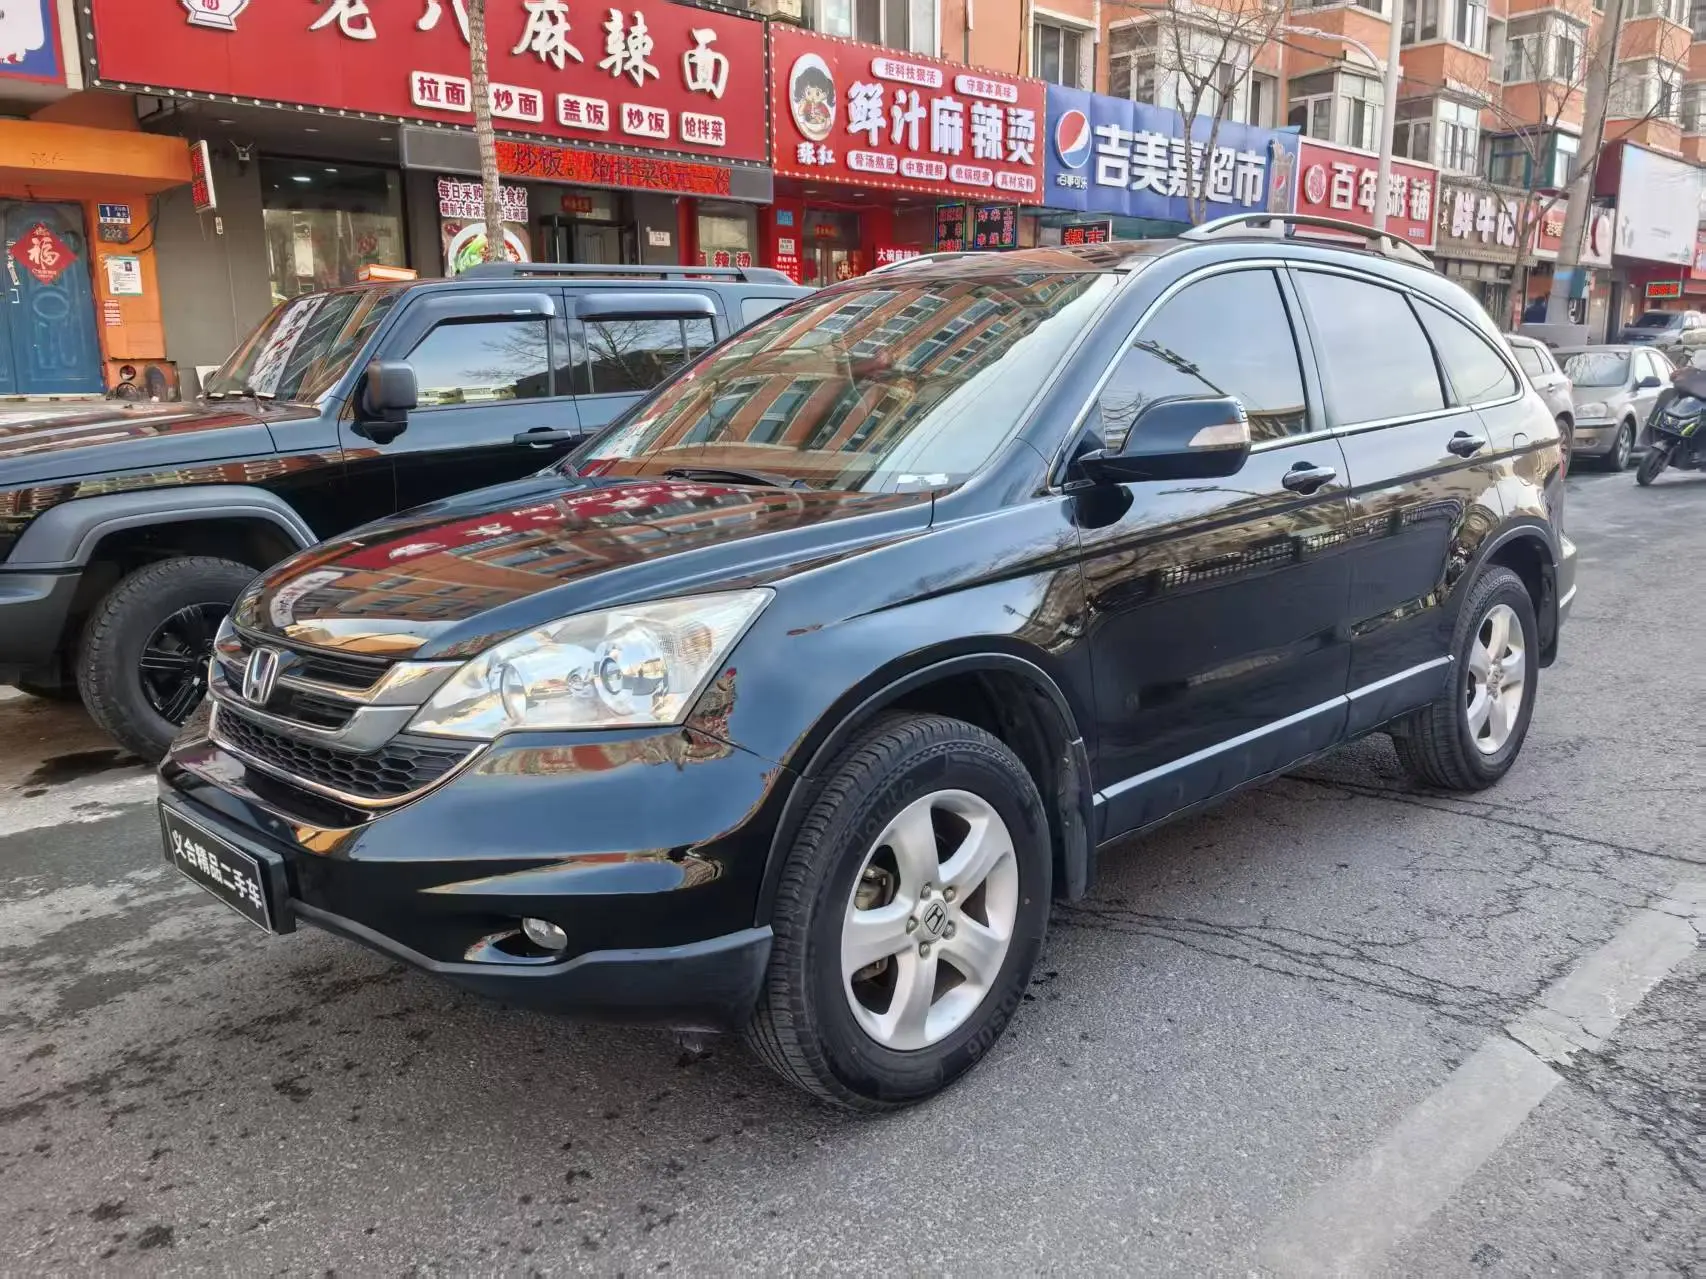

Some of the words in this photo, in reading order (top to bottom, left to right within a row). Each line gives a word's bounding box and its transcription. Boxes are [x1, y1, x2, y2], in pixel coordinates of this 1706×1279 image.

[884, 62, 936, 84] 拒科技狠活
[418, 76, 466, 106] 拉面
[493, 88, 538, 116] 炒面
[563, 98, 605, 126] 盖饭
[627, 107, 665, 133] 炒饭
[685, 117, 725, 141] 炝拌菜
[846, 80, 1035, 165] 鲜汁麻辣烫
[855, 153, 895, 171] 骨汤熬底
[1001, 174, 1033, 190] 真材实料
[1057, 174, 1088, 190] 百事可乐
[1095, 124, 1267, 208] 吉美嘉超市
[439, 182, 528, 205] 每日采购食材
[1330, 160, 1431, 221] 百年粥铺
[27, 236, 60, 270] 福
[1064, 226, 1106, 246] 超市
[697, 250, 752, 268] 辣烫
